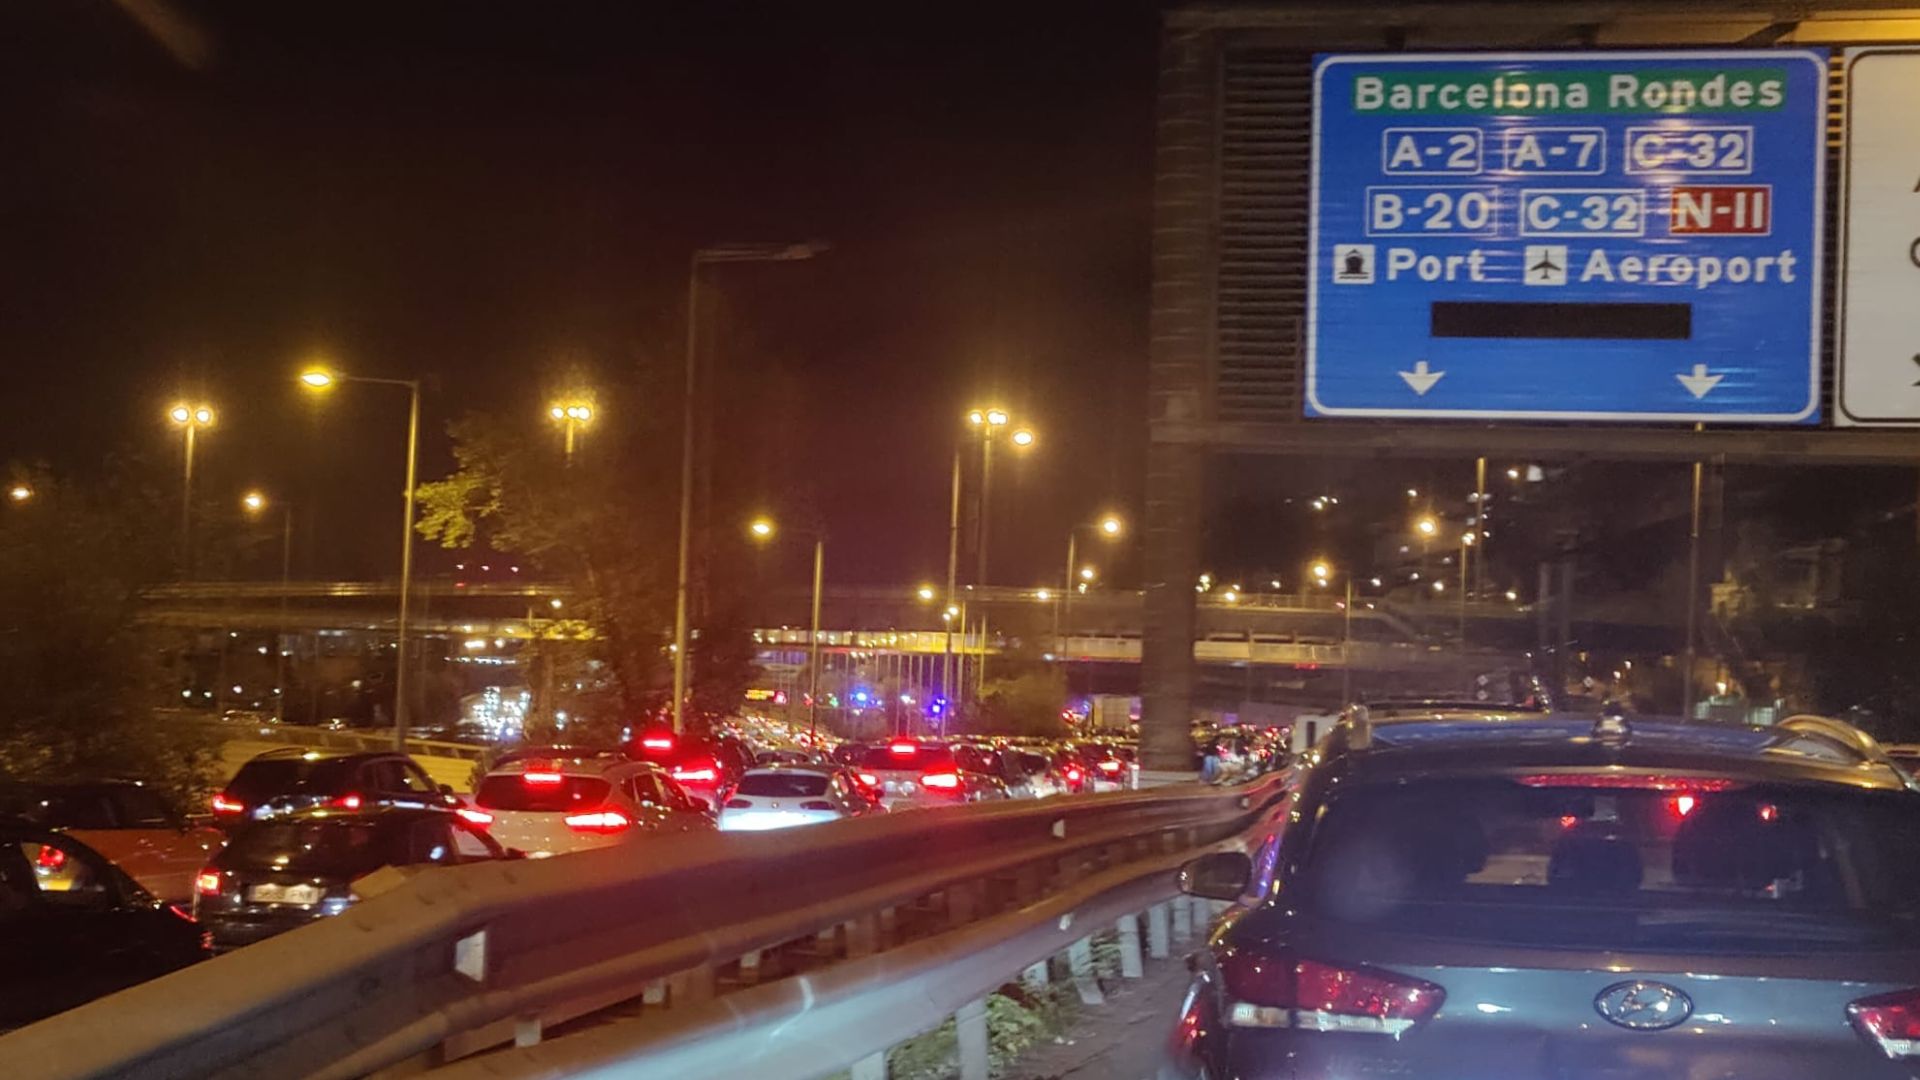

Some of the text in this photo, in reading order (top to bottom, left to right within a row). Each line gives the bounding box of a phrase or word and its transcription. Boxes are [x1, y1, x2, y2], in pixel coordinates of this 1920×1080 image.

[1355, 73, 1783, 110] Barcelona Rondes
[1389, 133, 1746, 168] A-2 A-7 C-32
[1373, 192, 1489, 230] B-20
[1527, 195, 1638, 230] C-32
[1386, 247, 1797, 289] Port Aeroport
